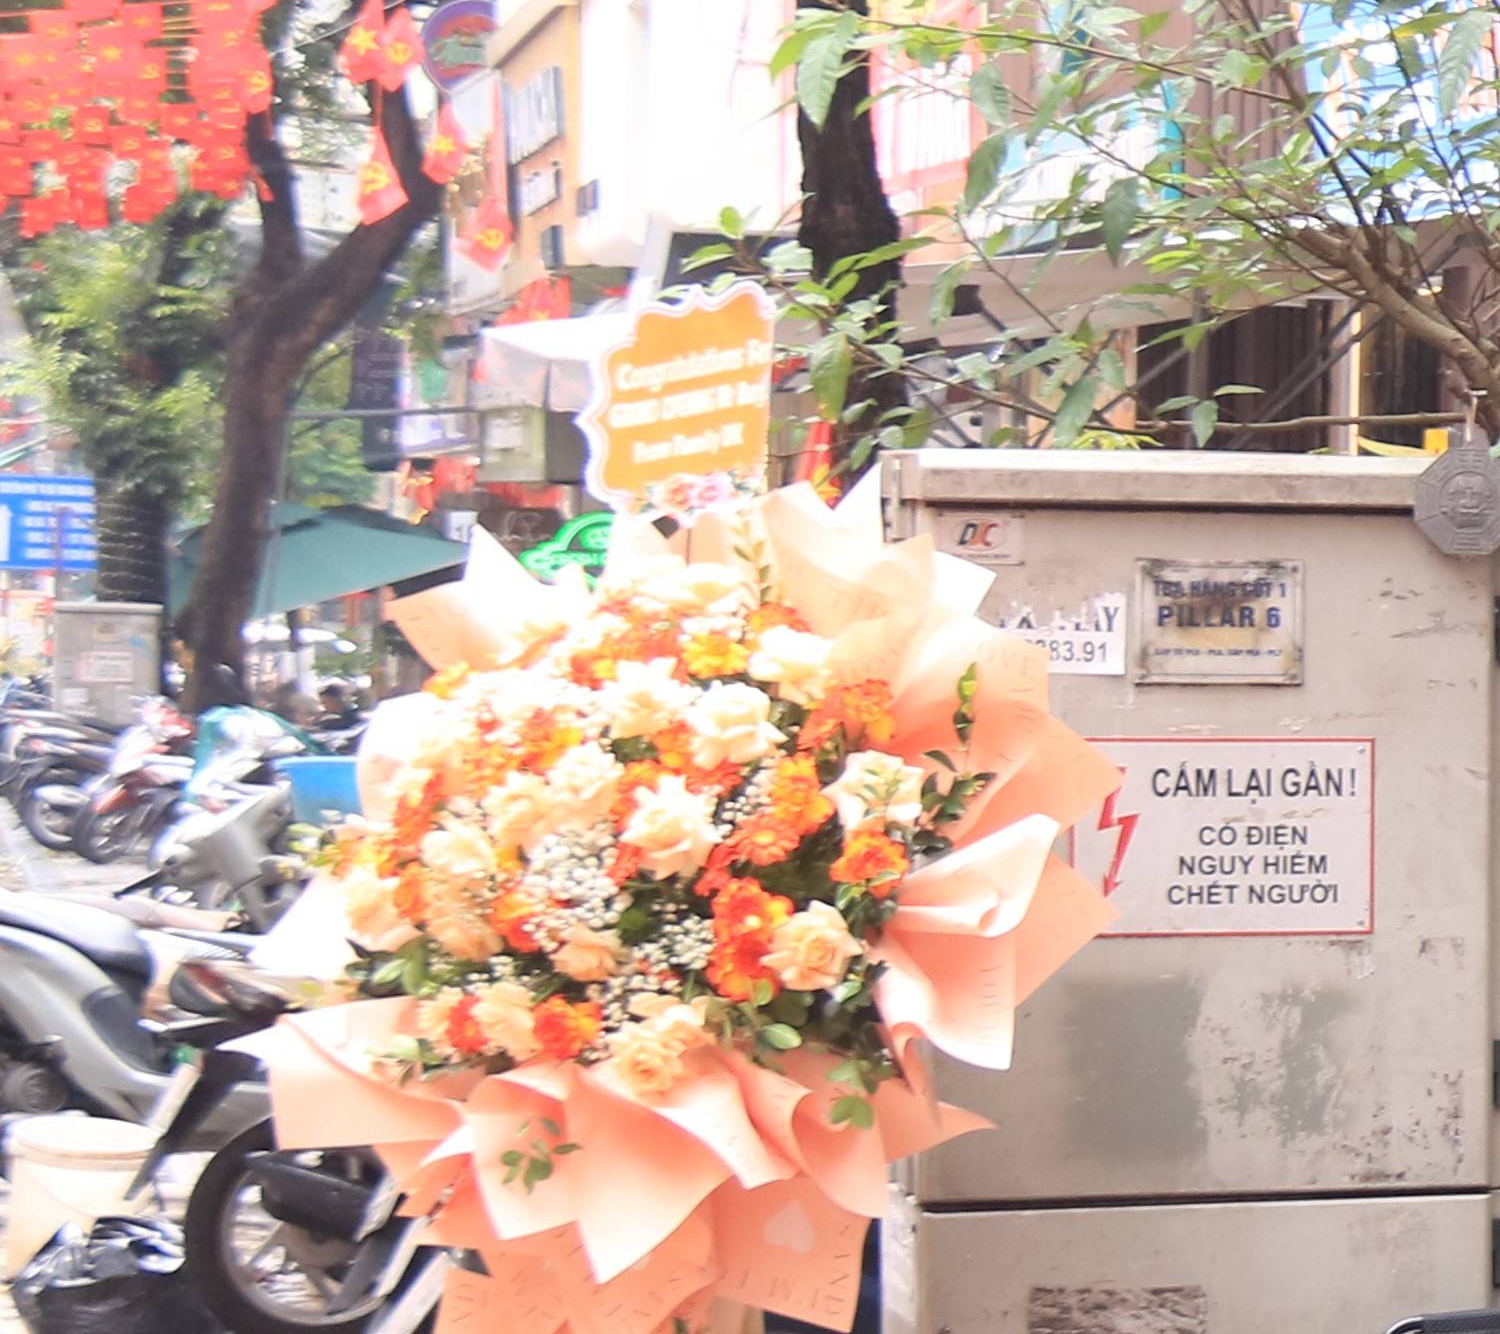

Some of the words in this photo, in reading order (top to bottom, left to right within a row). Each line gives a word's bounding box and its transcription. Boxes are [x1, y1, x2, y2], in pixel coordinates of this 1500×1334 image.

[1156, 605, 1256, 628] PILLAR
[1266, 606, 1282, 629] 6
[1226, 768, 1275, 806] LẠI
[1199, 823, 1239, 847] CÓ
[1245, 822, 1309, 849] ĐIỆN
[1178, 855, 1254, 876] NGUY
